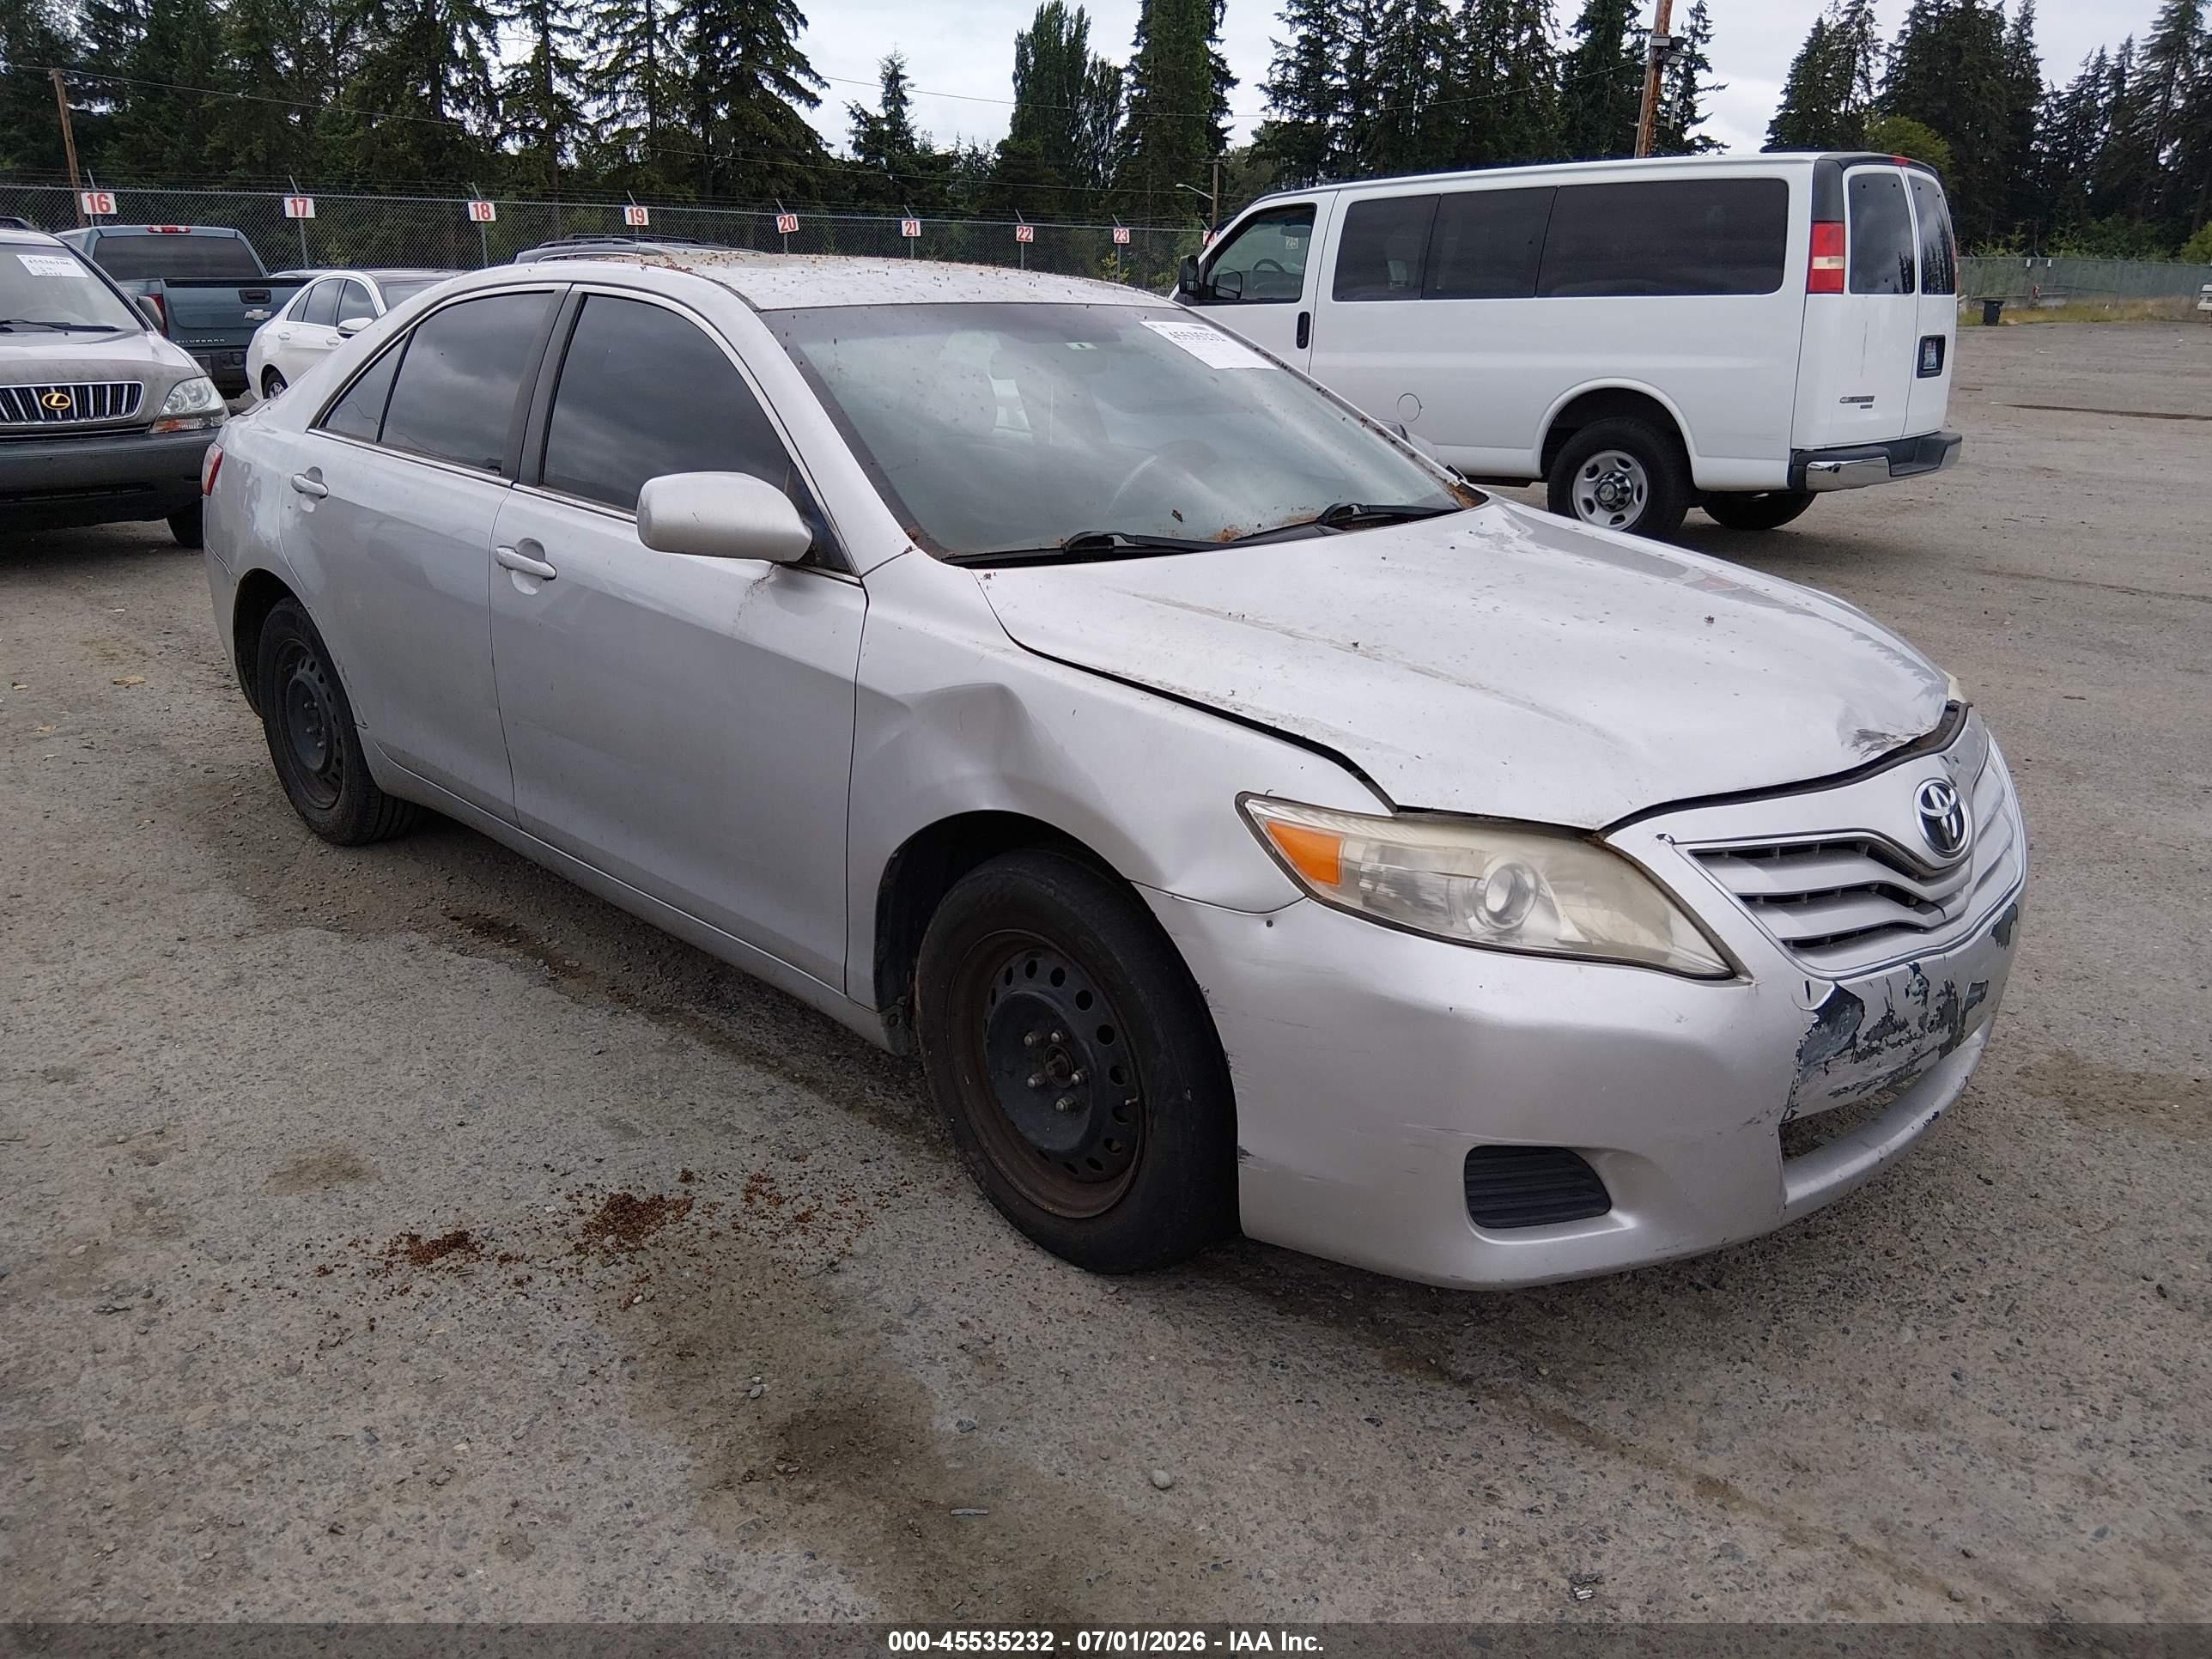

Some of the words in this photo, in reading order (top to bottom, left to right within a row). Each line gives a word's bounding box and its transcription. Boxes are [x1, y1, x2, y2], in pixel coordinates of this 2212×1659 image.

[87, 193, 111, 213] 16
[292, 198, 307, 216] 17
[473, 202, 492, 221] 18
[629, 207, 646, 223] 19
[778, 216, 797, 232] 20
[905, 221, 918, 236] 21
[1018, 227, 1032, 241] 22
[1115, 230, 1128, 242] 23
